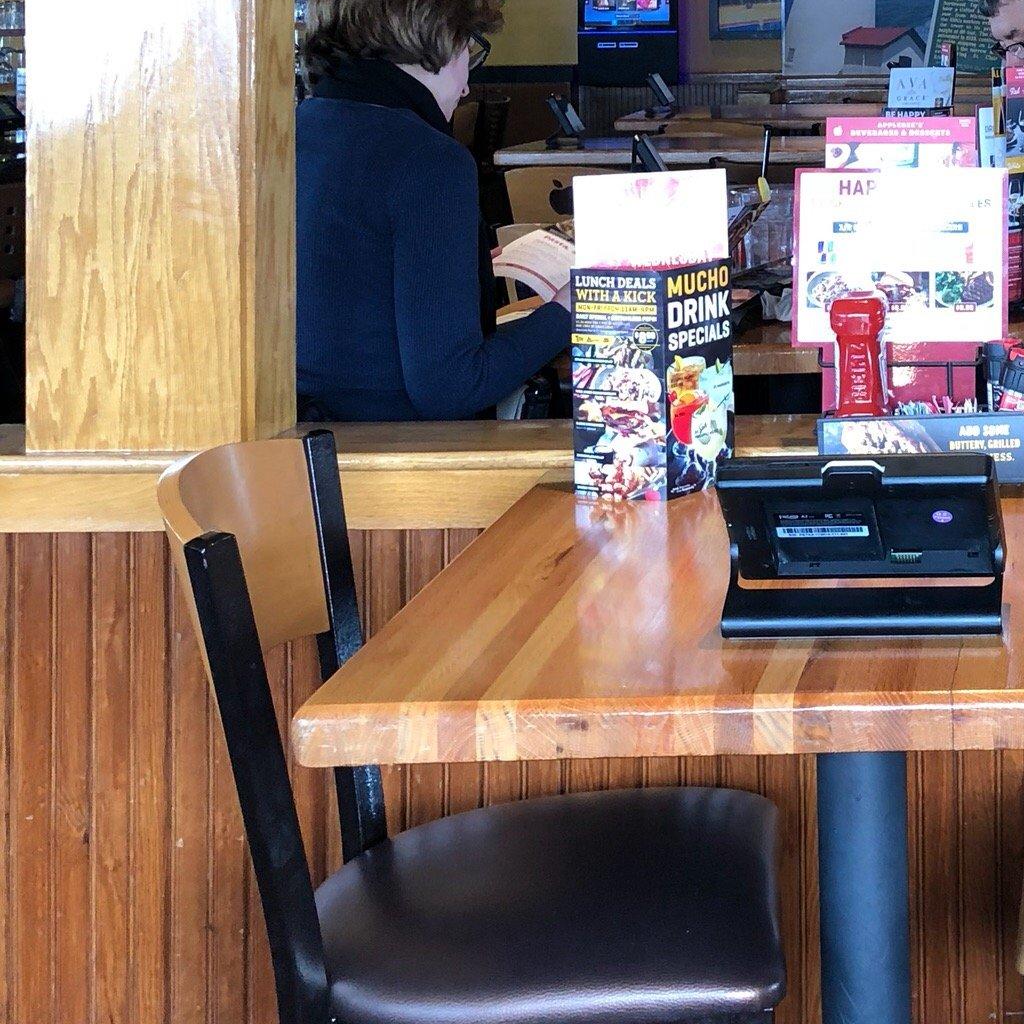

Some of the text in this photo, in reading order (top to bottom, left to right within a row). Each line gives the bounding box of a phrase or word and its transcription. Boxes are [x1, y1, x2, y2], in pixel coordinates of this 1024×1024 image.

[575, 276, 657, 289] LUNCH DEALS
[667, 265, 729, 299] MUCHO
[575, 288, 657, 304] WITH A KICK
[667, 290, 731, 329] DRINK
[668, 320, 730, 351] SPECIALS
[958, 424, 1011, 436] ADD SOME
[949, 438, 1021, 451] BUTTERY, GRILLED
